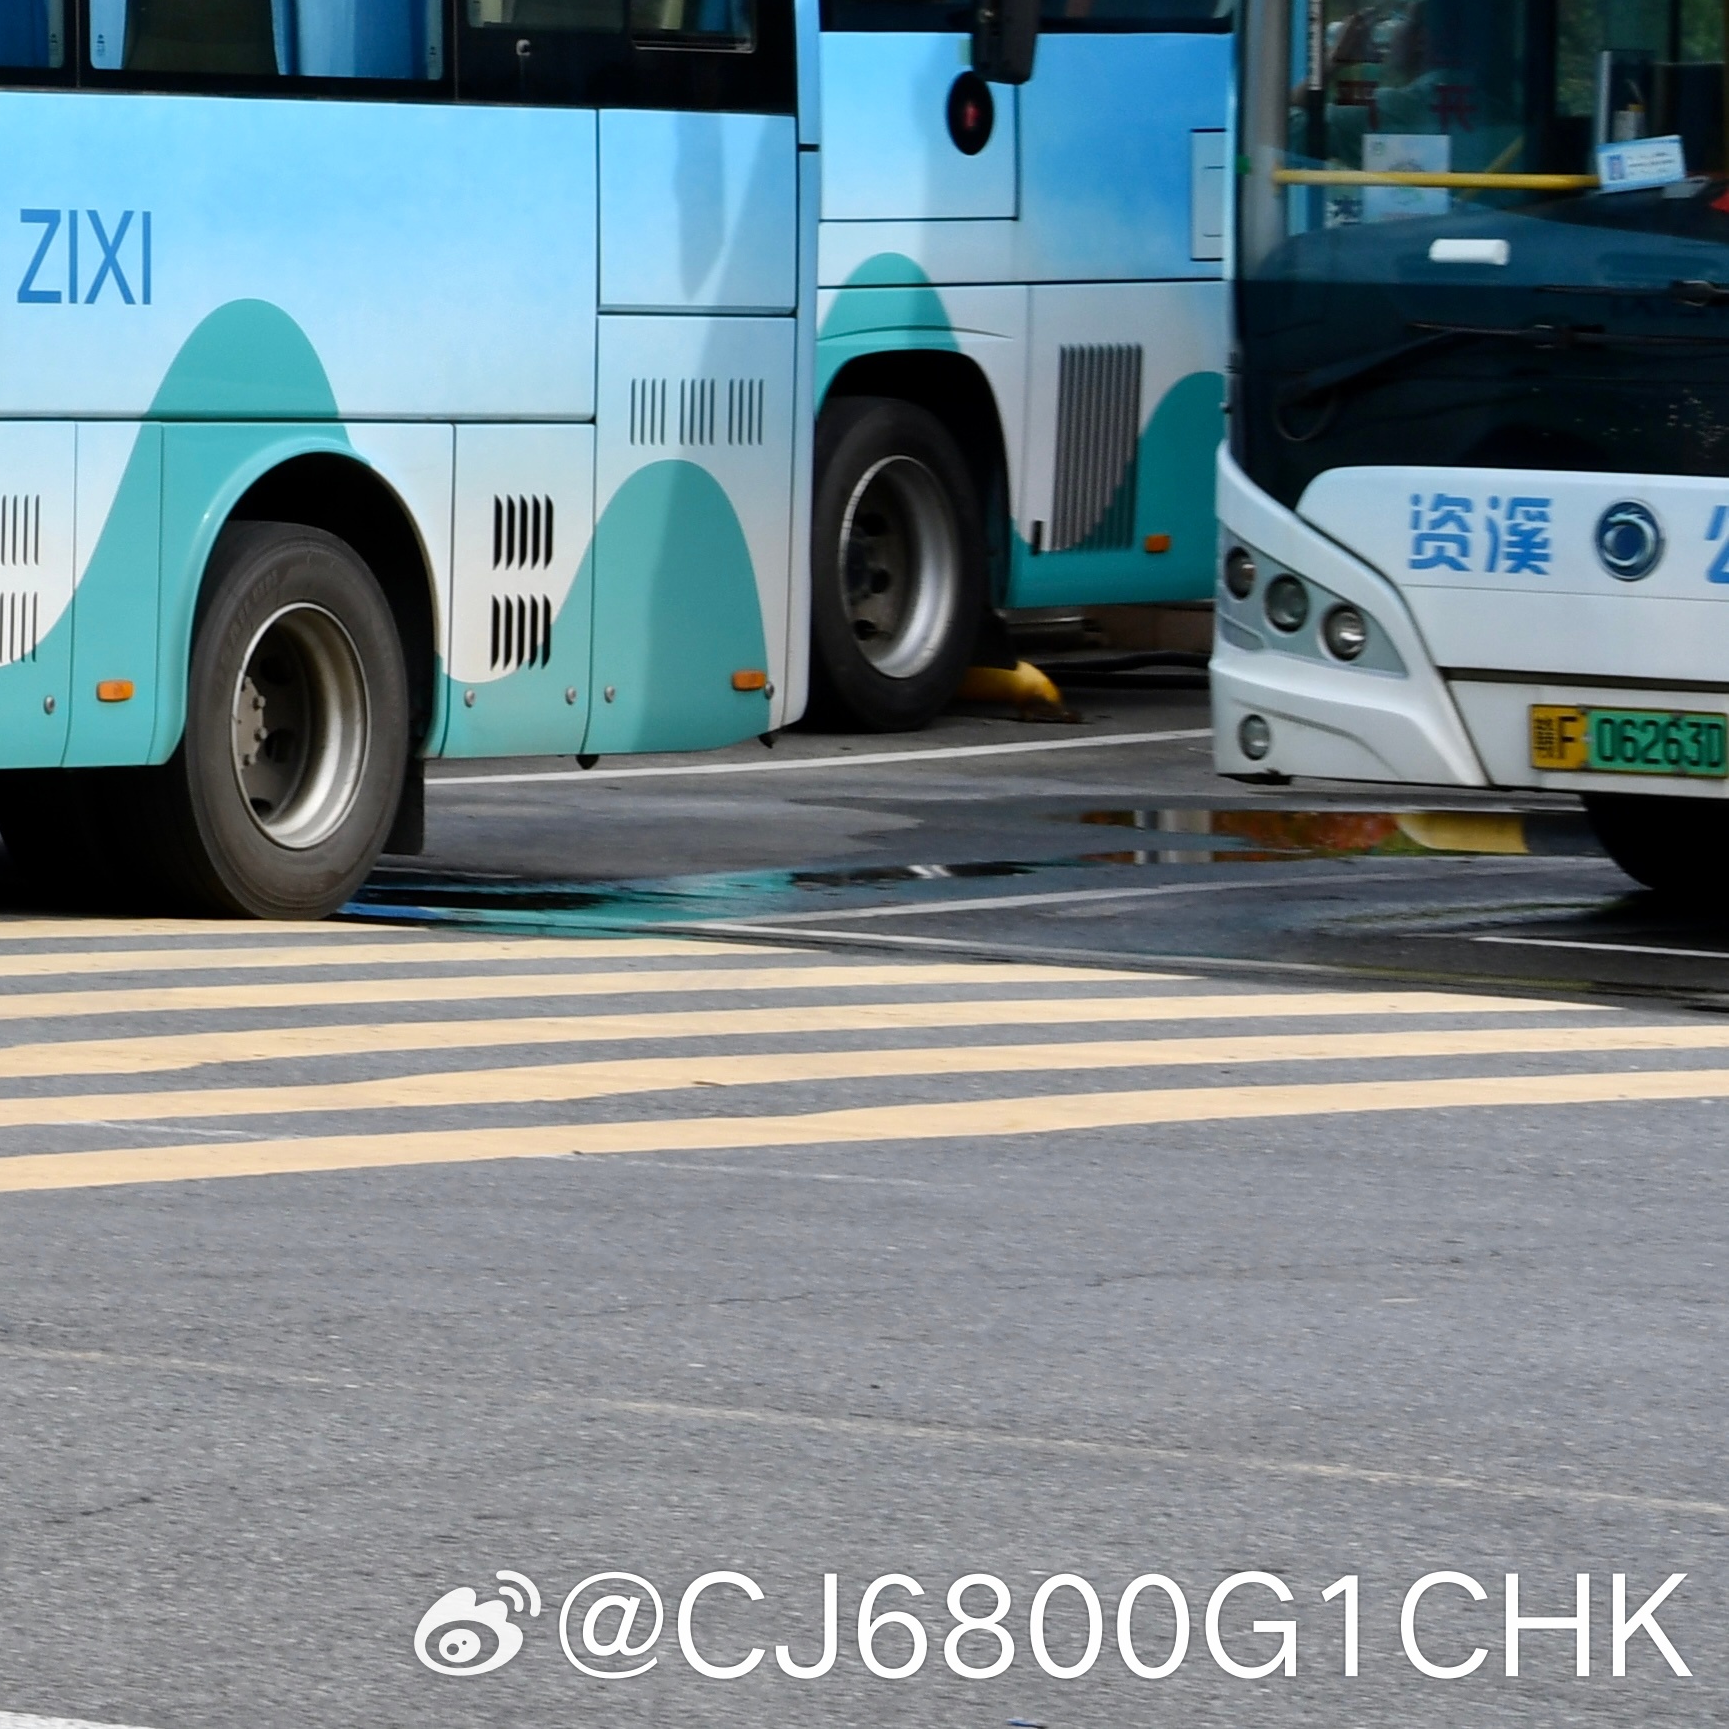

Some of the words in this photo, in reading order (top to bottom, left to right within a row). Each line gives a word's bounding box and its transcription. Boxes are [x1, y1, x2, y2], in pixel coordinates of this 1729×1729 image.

[17, 208, 152, 306] ZIXI
[1408, 493, 1554, 576] 资溪
[1596, 717, 1724, 768] 06263D
